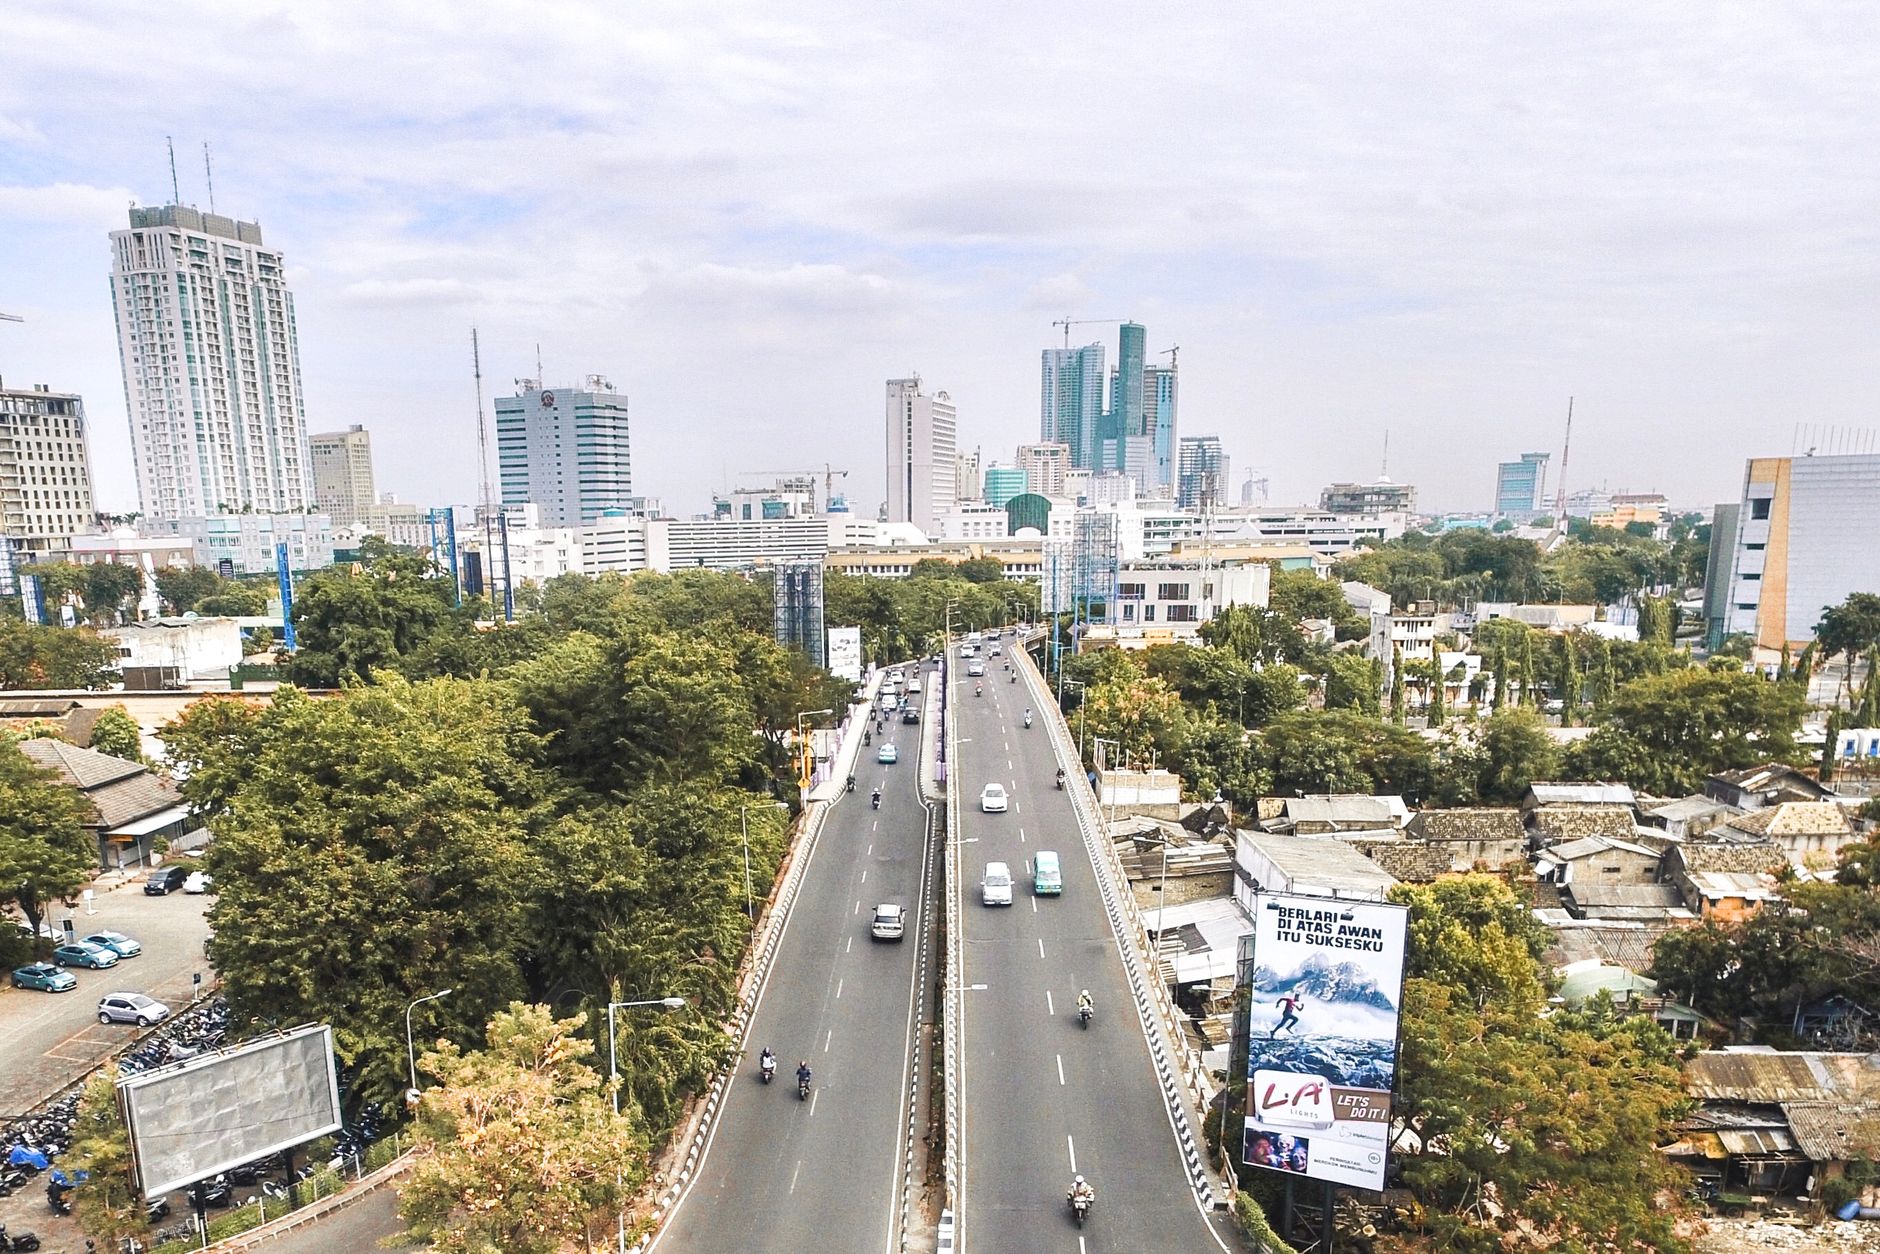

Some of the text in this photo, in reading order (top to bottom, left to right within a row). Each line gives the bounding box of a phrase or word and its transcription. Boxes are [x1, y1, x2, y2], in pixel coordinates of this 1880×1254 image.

[1278, 907, 1338, 923] BERLARI
[1278, 918, 1382, 940] DI ATAS AWAN
[1277, 931, 1384, 953] ITU SUKSESKU
[1337, 1095, 1370, 1107] LET'S
[1290, 1109, 1319, 1119] LIGHTS
[1350, 1108, 1366, 1118] DO
